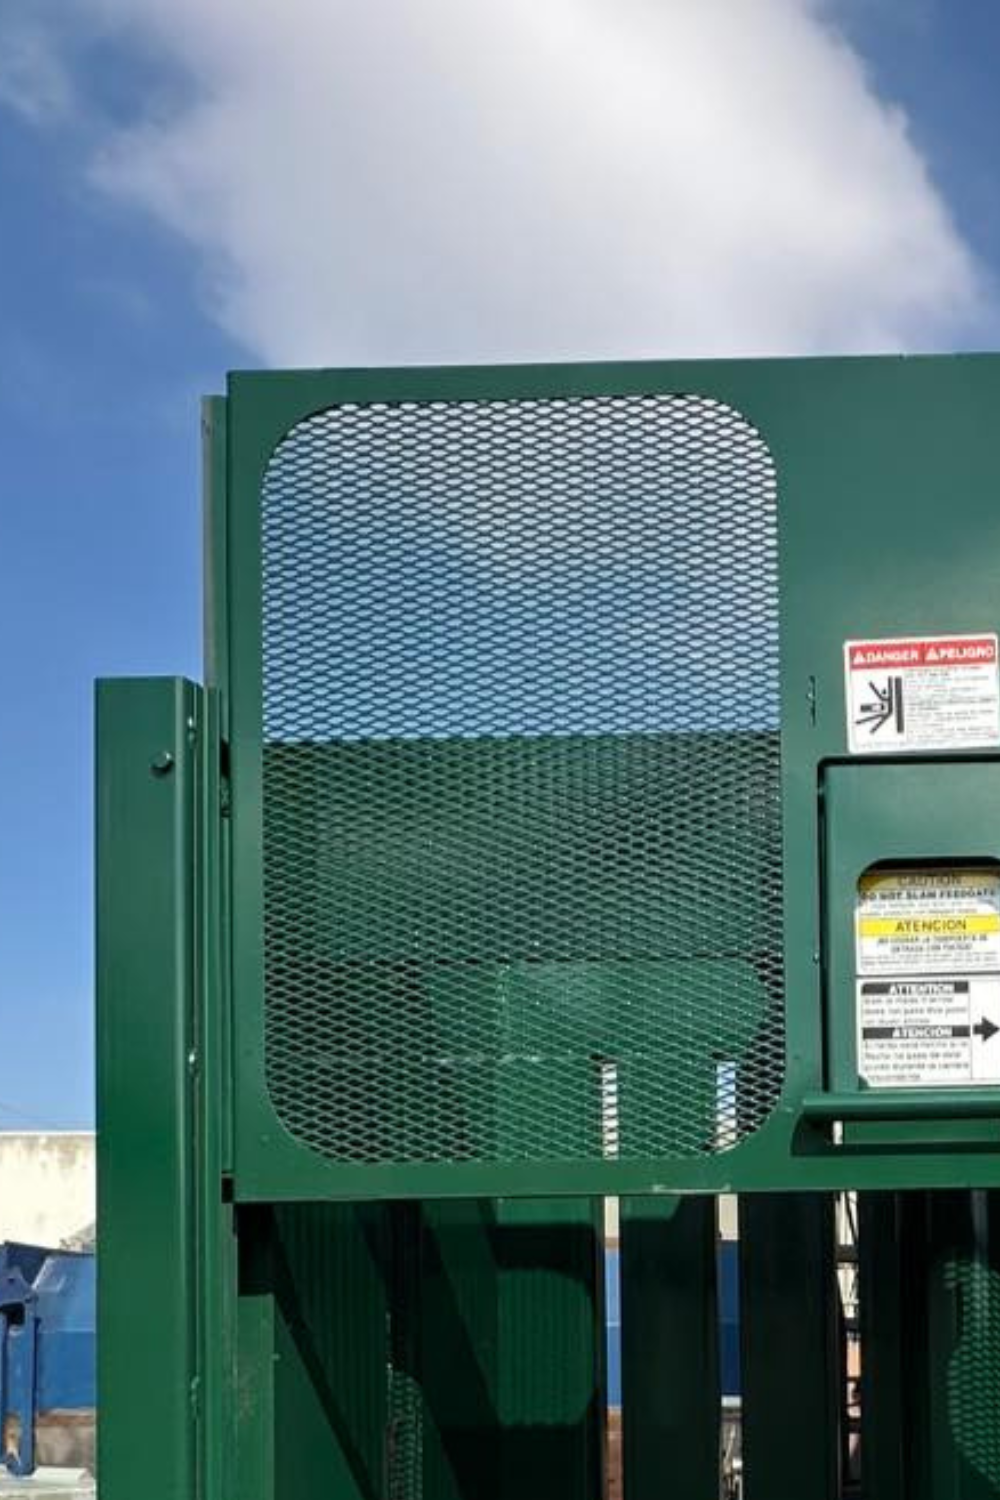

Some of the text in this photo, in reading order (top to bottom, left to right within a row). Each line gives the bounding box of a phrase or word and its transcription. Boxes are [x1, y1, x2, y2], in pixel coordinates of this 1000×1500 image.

[867, 650, 919, 663] DANGER
[938, 646, 994, 660] PELIGRO
[881, 891, 903, 901] NOT
[906, 890, 936, 900] SLAM
[895, 920, 967, 933] ATENCION
